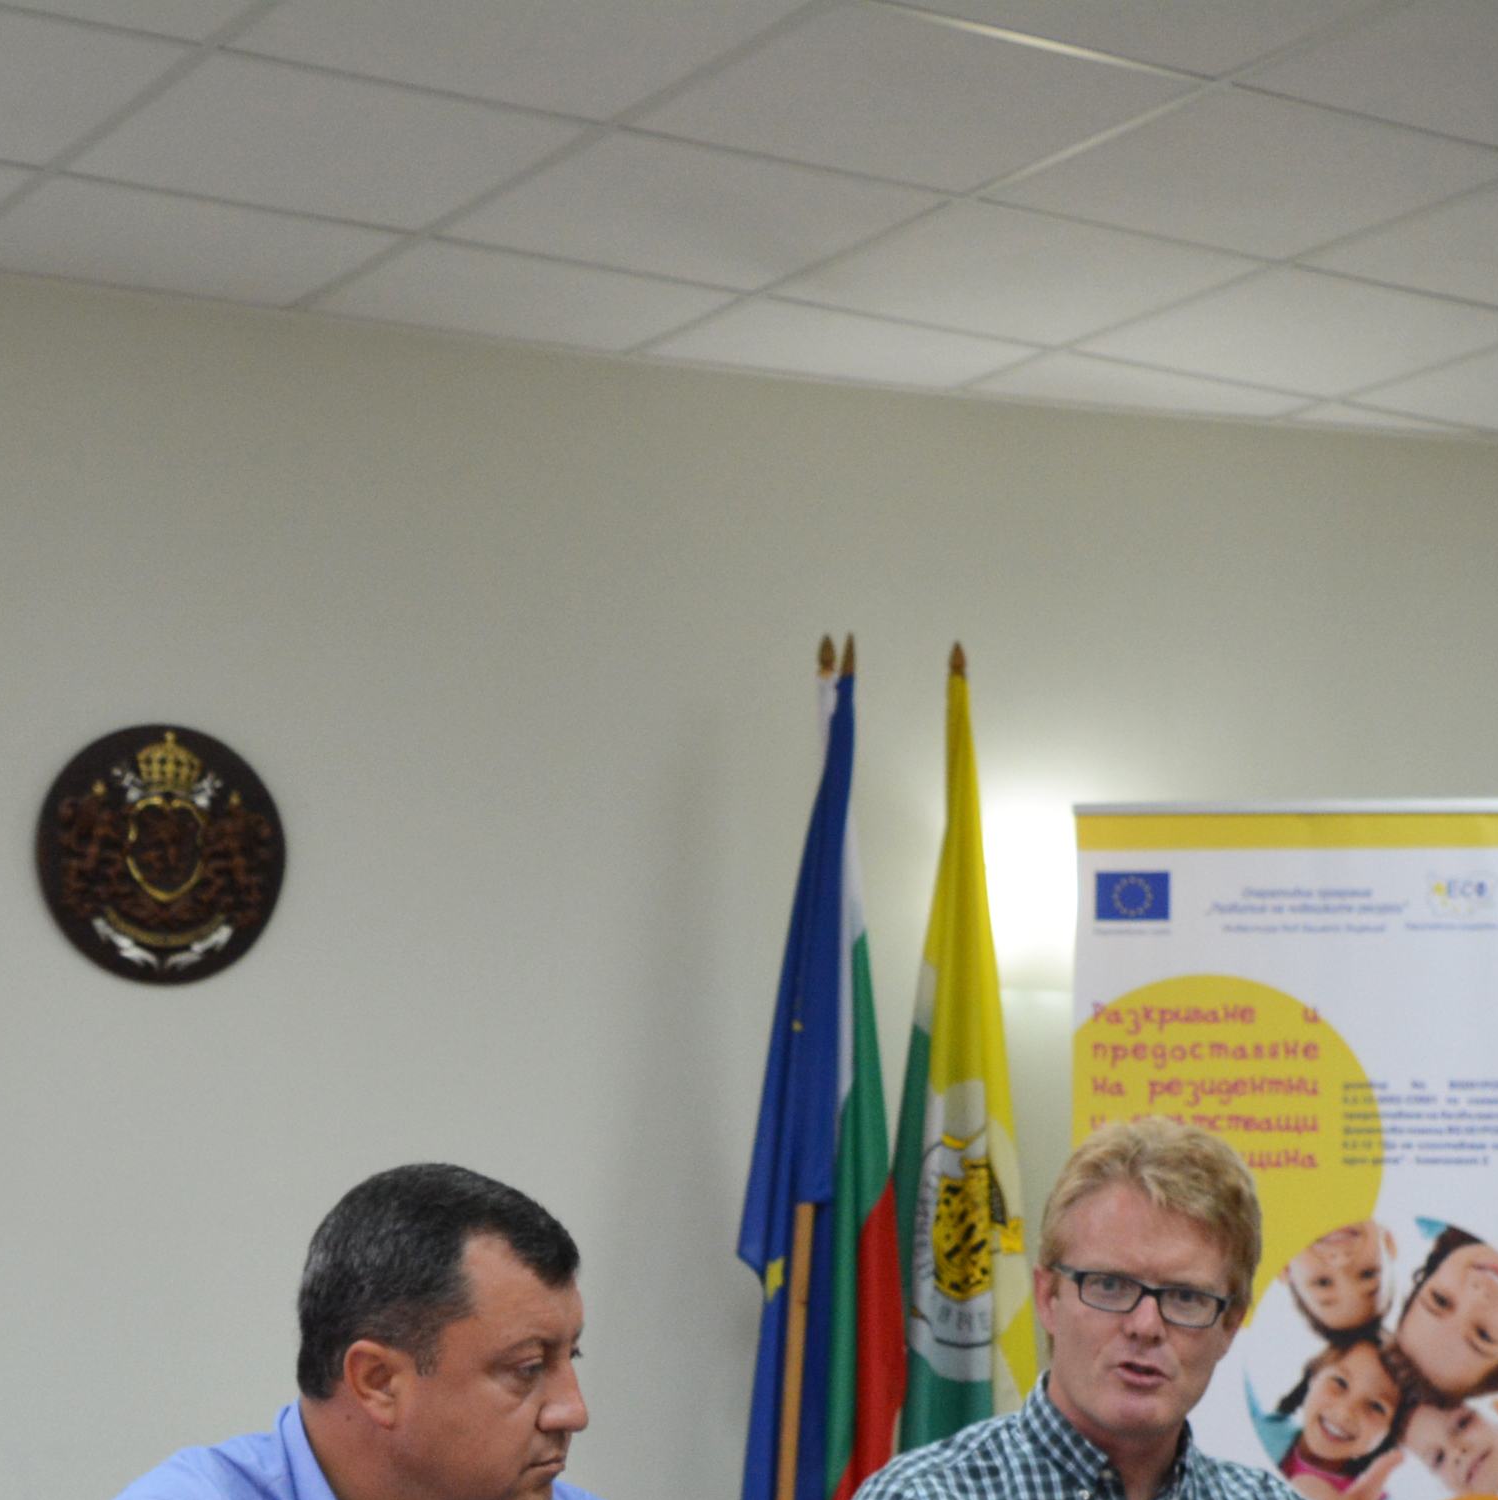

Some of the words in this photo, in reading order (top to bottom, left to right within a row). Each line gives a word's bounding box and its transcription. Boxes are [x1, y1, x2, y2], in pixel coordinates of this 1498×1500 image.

[1092, 1001, 1257, 1036] Разкриване
[1303, 1006, 1321, 1025] и
[1091, 1040, 1320, 1070] предоставяне
[1091, 1076, 1126, 1097] на
[1148, 1075, 1320, 1107] резидентни
[1131, 1113, 1320, 1136] тстващи
